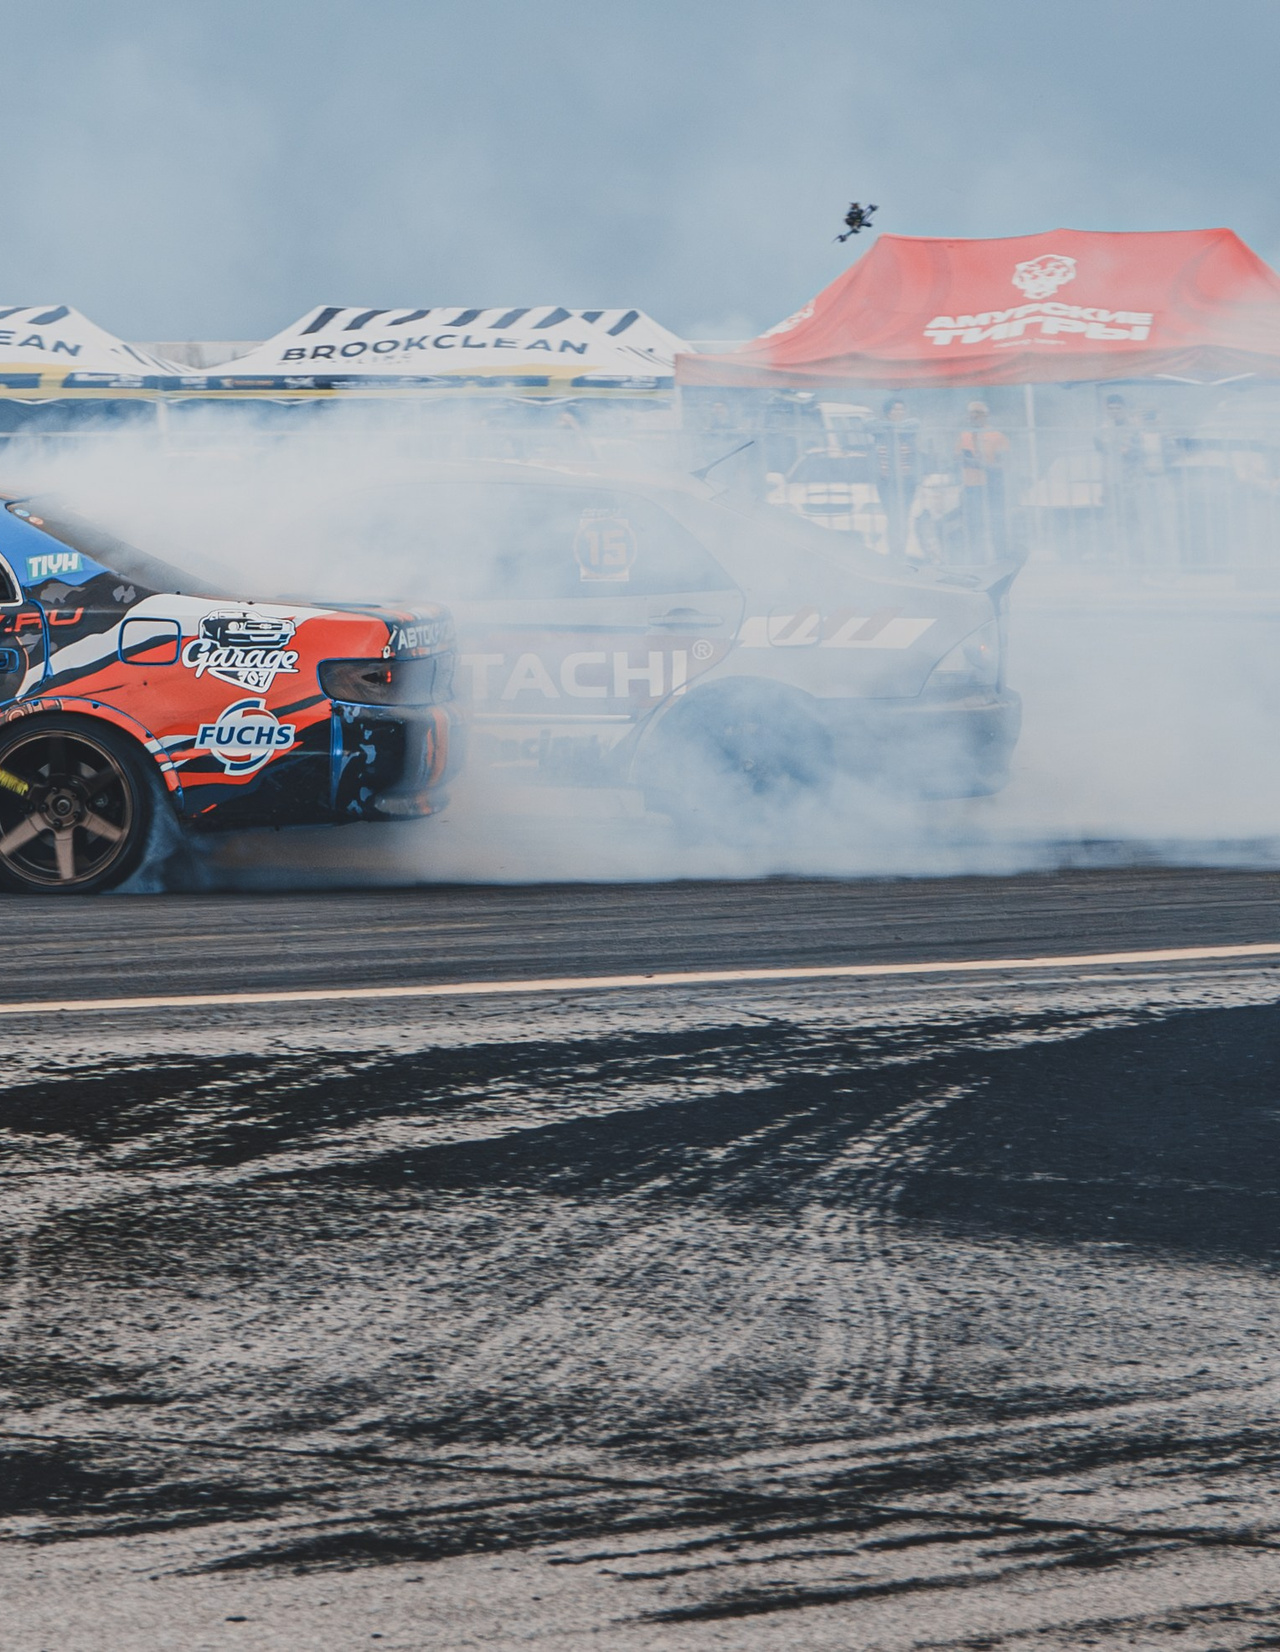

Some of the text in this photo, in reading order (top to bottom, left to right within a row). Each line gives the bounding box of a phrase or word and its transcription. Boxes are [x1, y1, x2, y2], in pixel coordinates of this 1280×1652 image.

[923, 315, 1151, 346] ТИГРЫ
[925, 302, 1155, 329] АМУРСКИЕ
[281, 333, 590, 361] BROOKCLEAN
[583, 529, 627, 566] 15
[182, 638, 300, 678] Garage
[460, 650, 688, 699] TACHI
[198, 726, 292, 745] FUCHS
